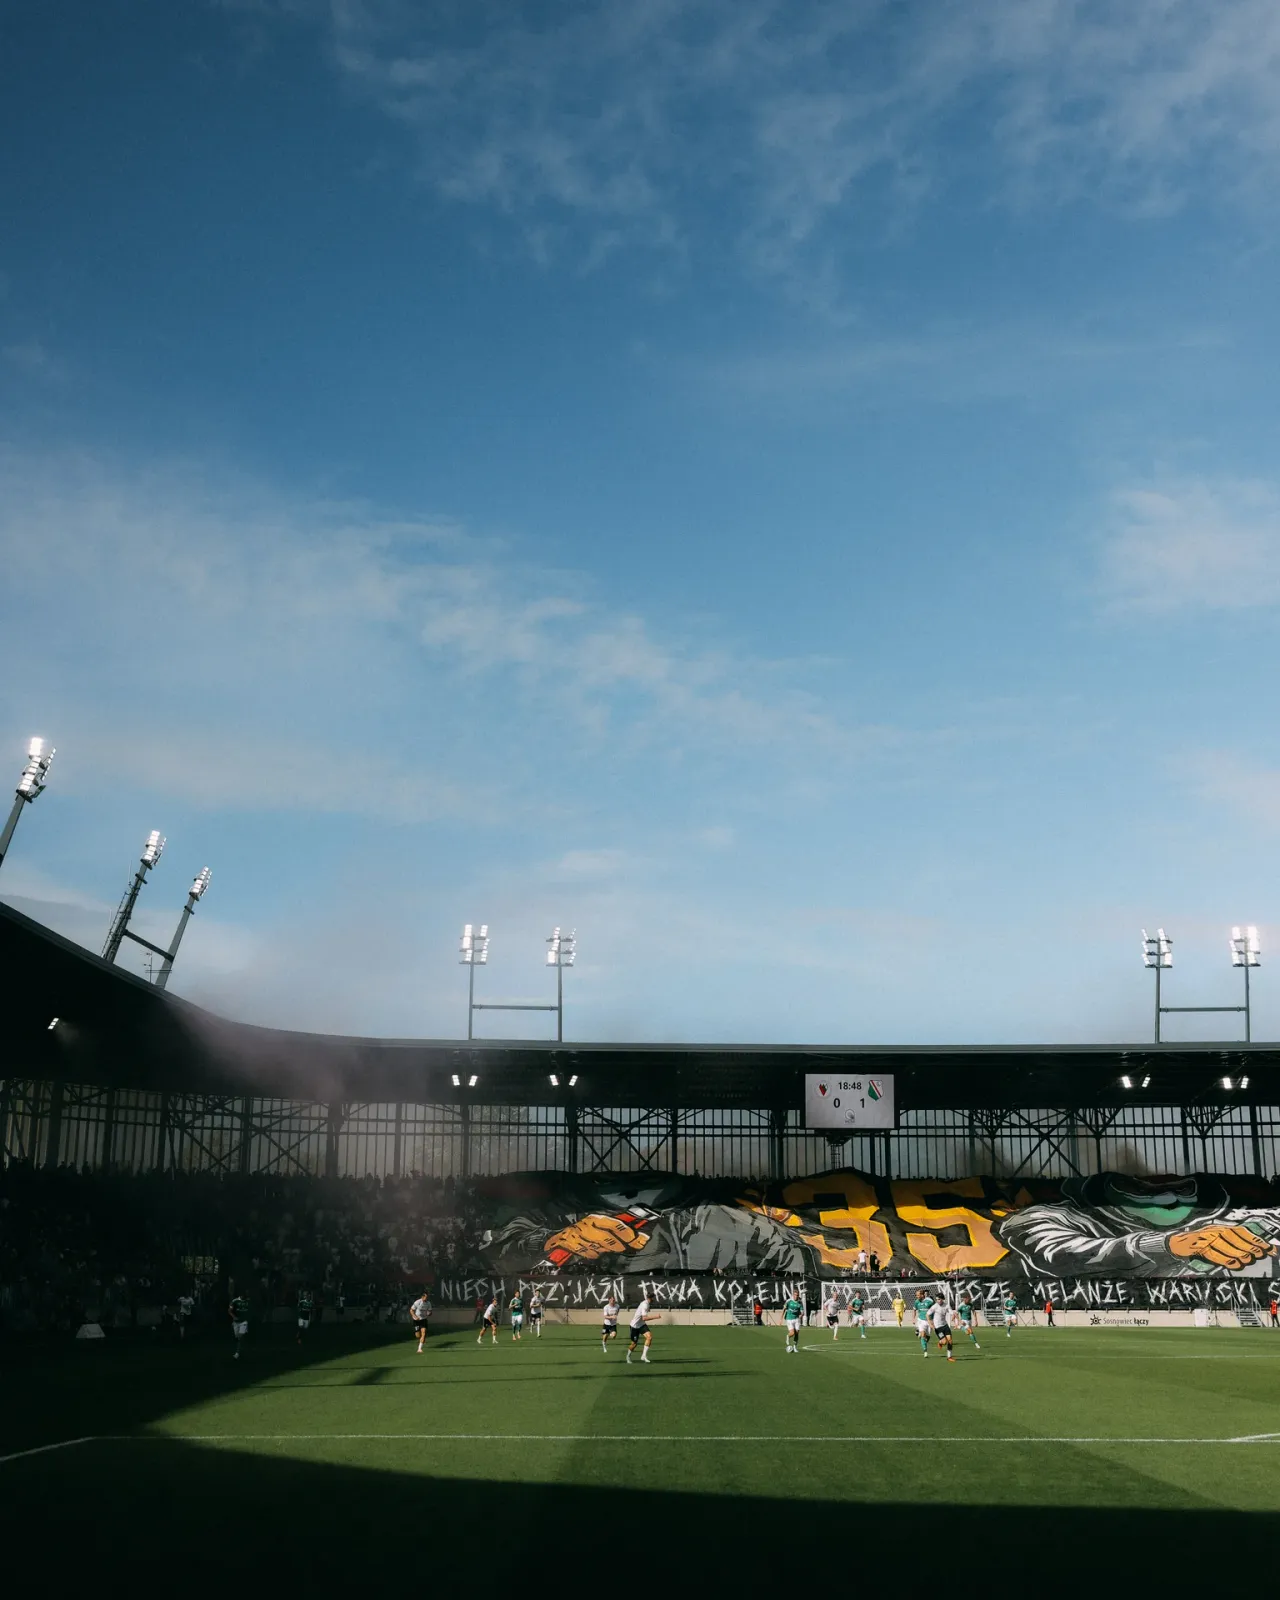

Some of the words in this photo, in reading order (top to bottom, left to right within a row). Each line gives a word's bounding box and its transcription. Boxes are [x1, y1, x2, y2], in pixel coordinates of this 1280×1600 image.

[838, 1082, 862, 1090] 18:48
[833, 1098, 841, 1108] 0
[860, 1098, 865, 1108] 1
[782, 1172, 1010, 1274] 35
[441, 1277, 506, 1301] NIECH
[638, 1277, 703, 1303] TRWA
[1103, 1317, 1133, 1325] Sosnowiec
[1134, 1317, 1149, 1326] łączy
